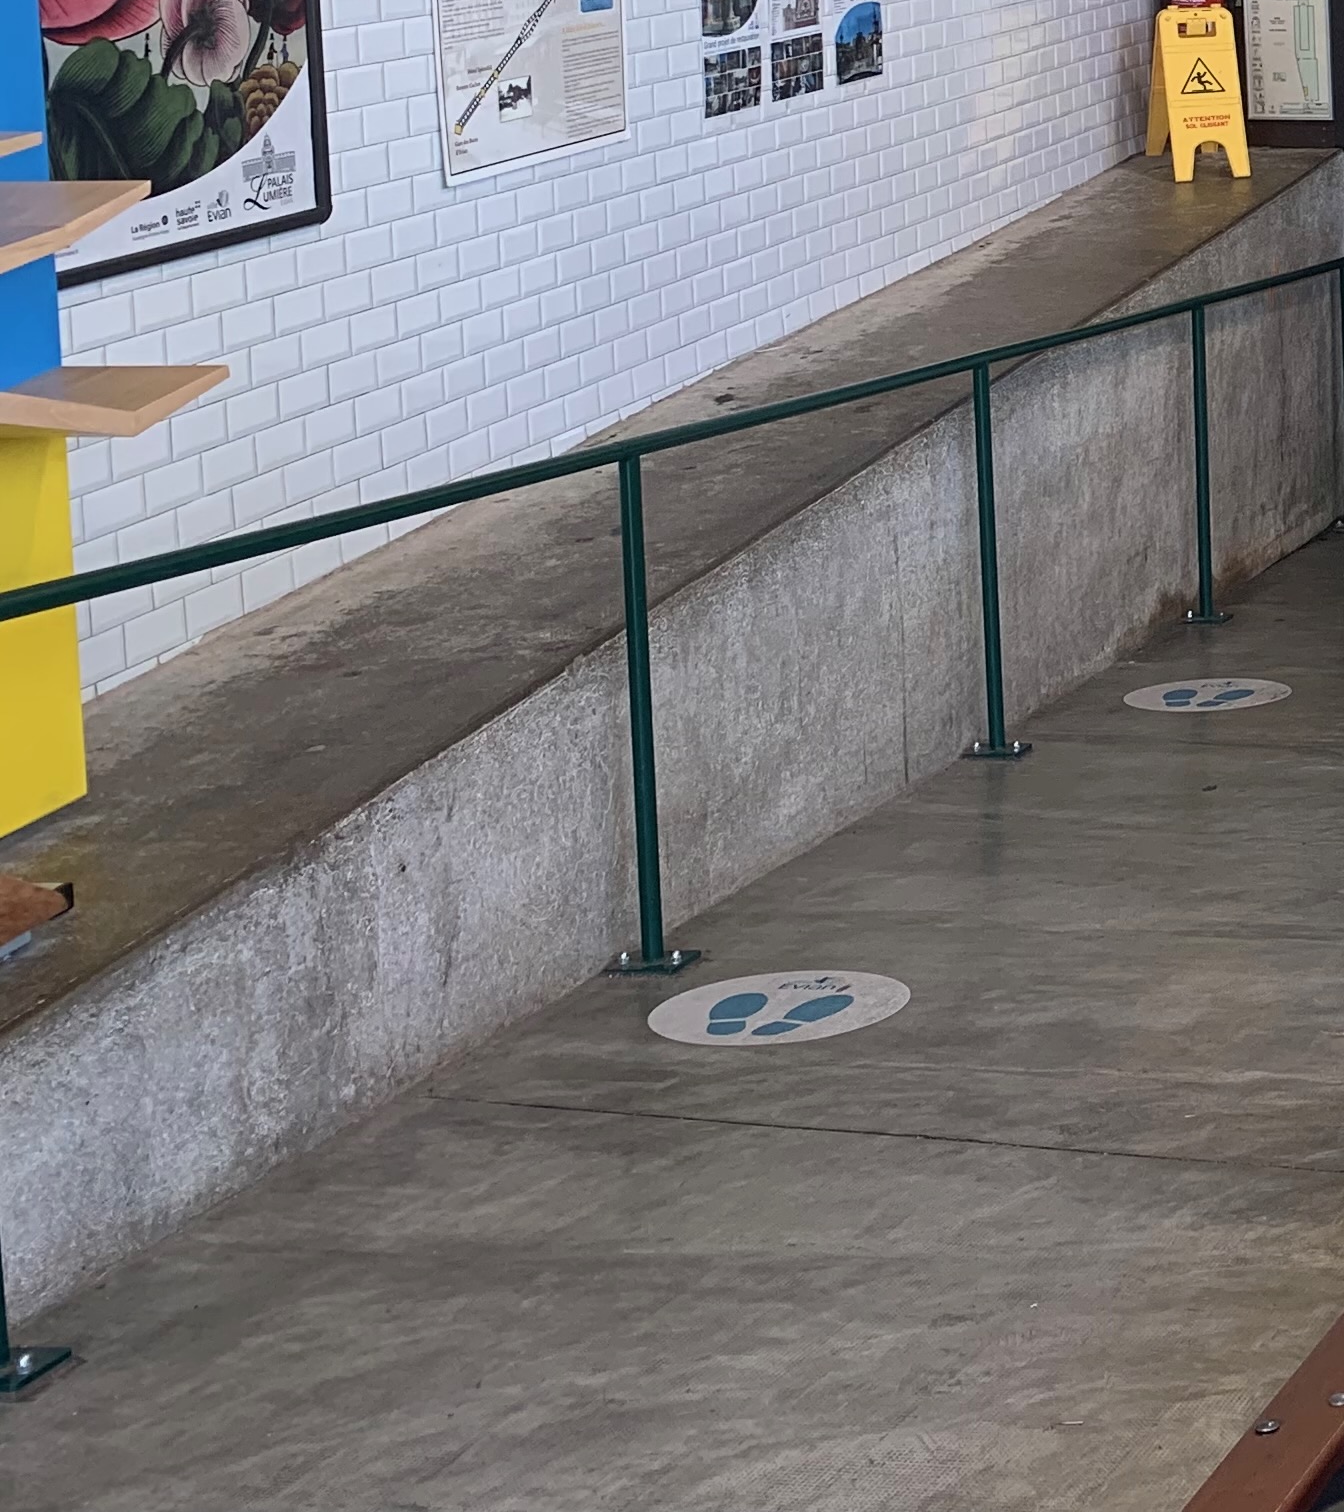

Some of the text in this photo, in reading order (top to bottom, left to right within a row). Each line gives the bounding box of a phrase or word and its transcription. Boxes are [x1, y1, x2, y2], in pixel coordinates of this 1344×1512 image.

[1183, 114, 1230, 122] ATTENTION
[267, 173, 294, 188] PALAIS
[176, 214, 198, 225] savoie
[131, 226, 138, 234] La
